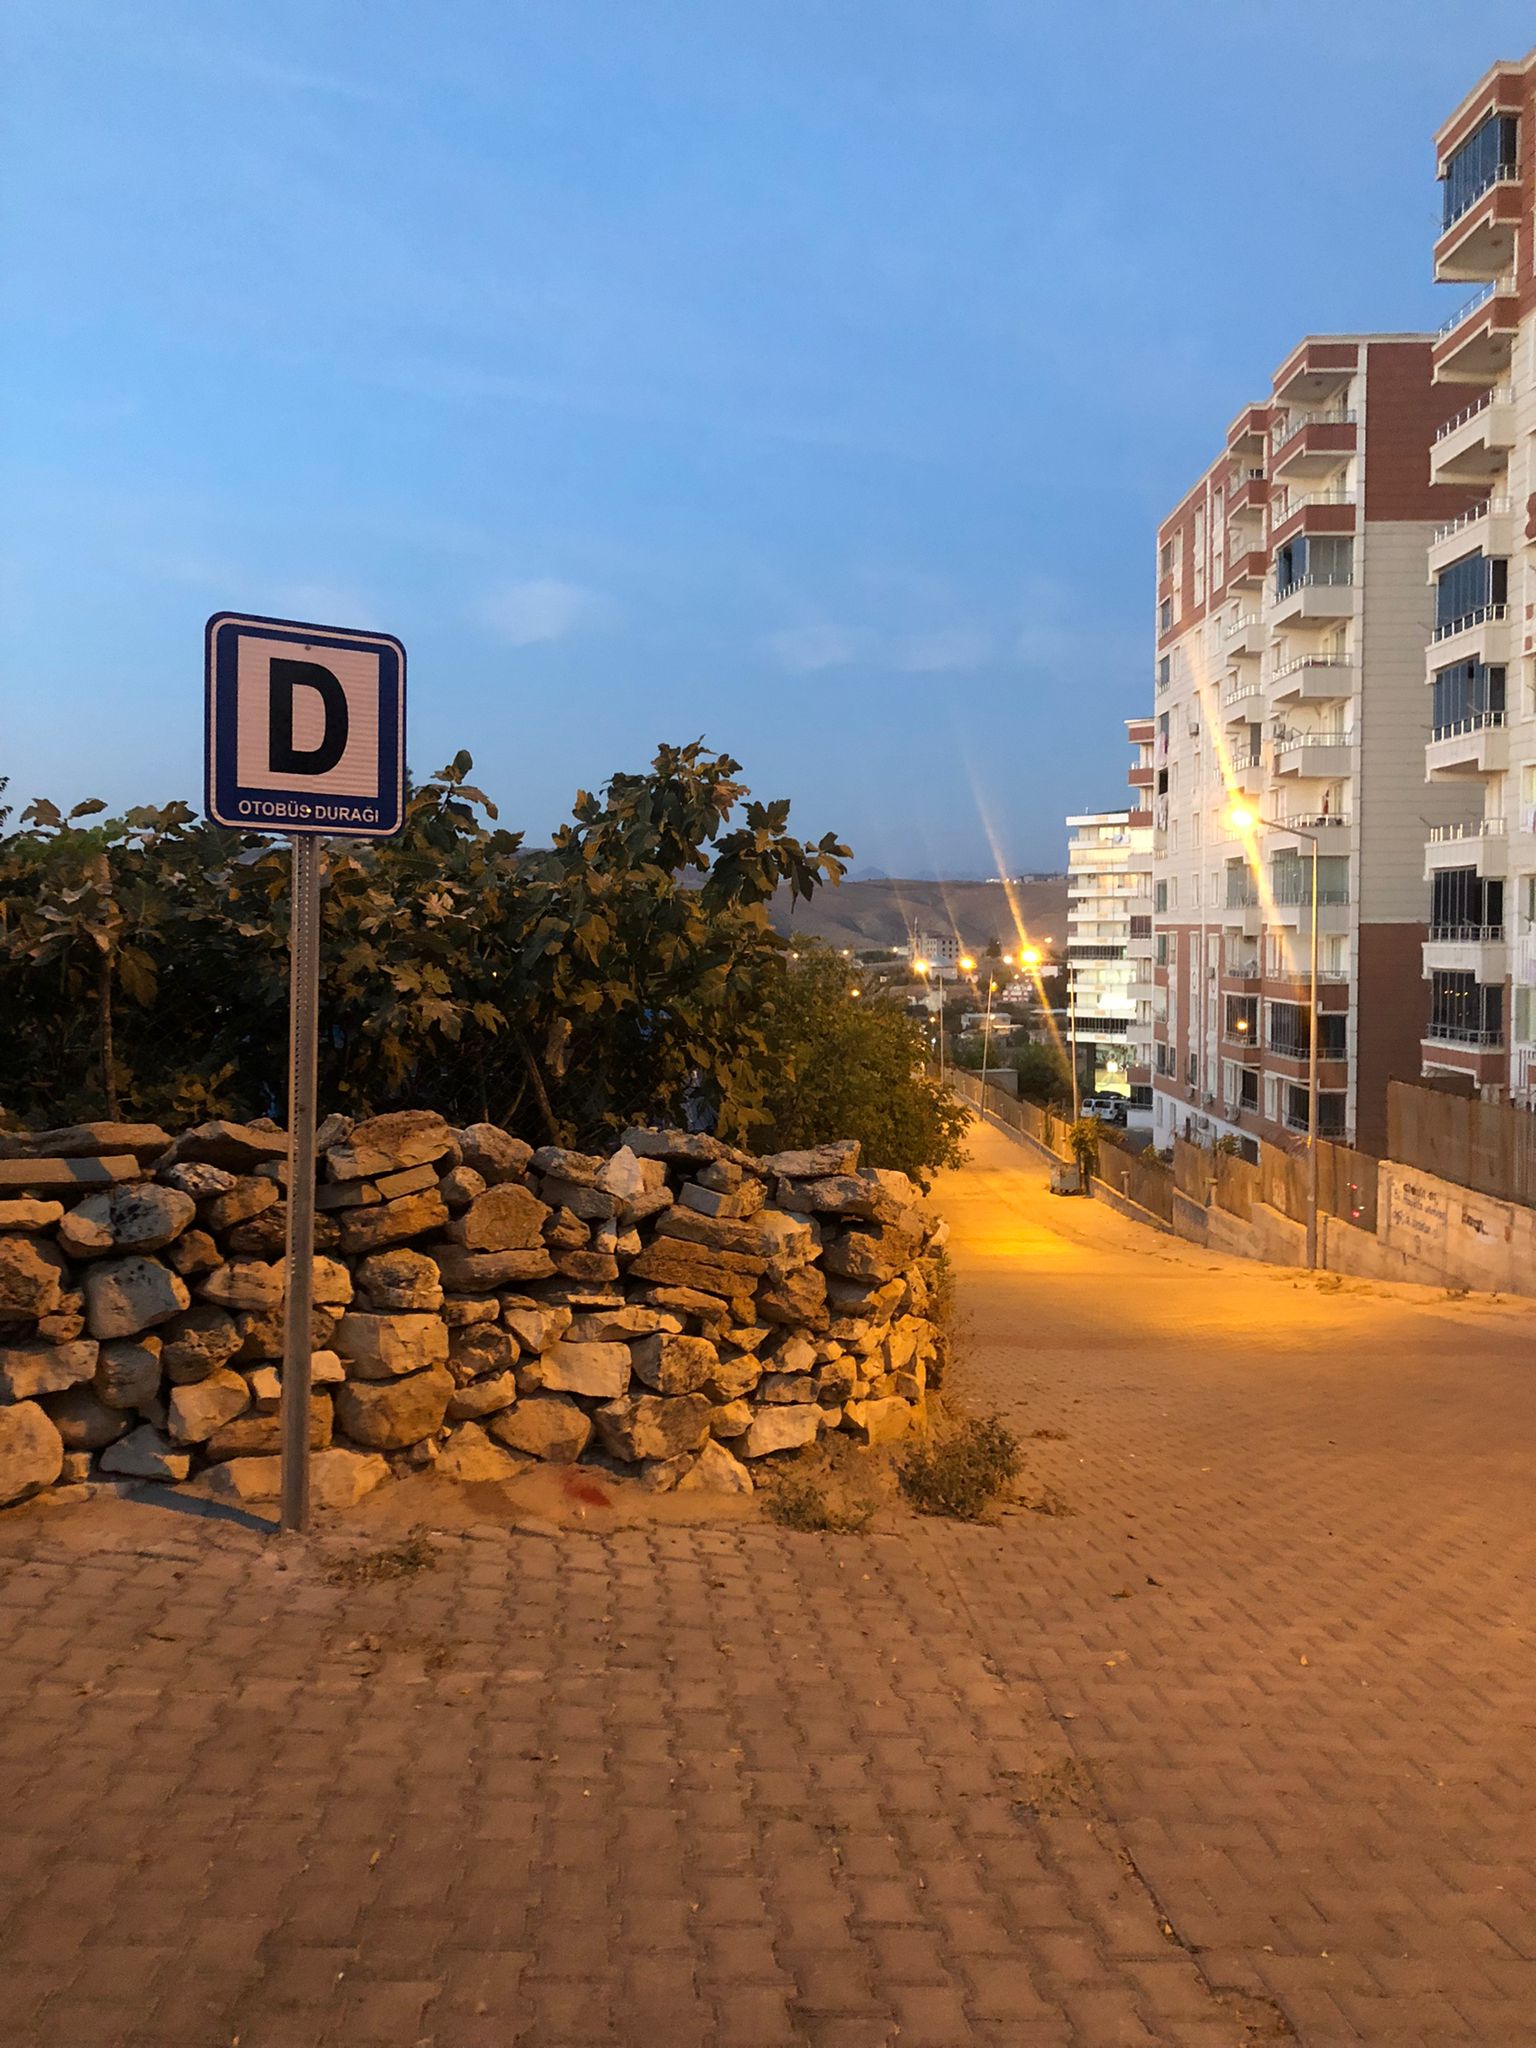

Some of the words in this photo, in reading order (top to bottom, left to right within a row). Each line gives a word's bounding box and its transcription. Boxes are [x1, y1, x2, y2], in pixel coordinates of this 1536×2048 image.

[269, 657, 348, 775] D
[238, 799, 310, 818] OTOBÜS
[314, 805, 379, 823] DURAĞI
